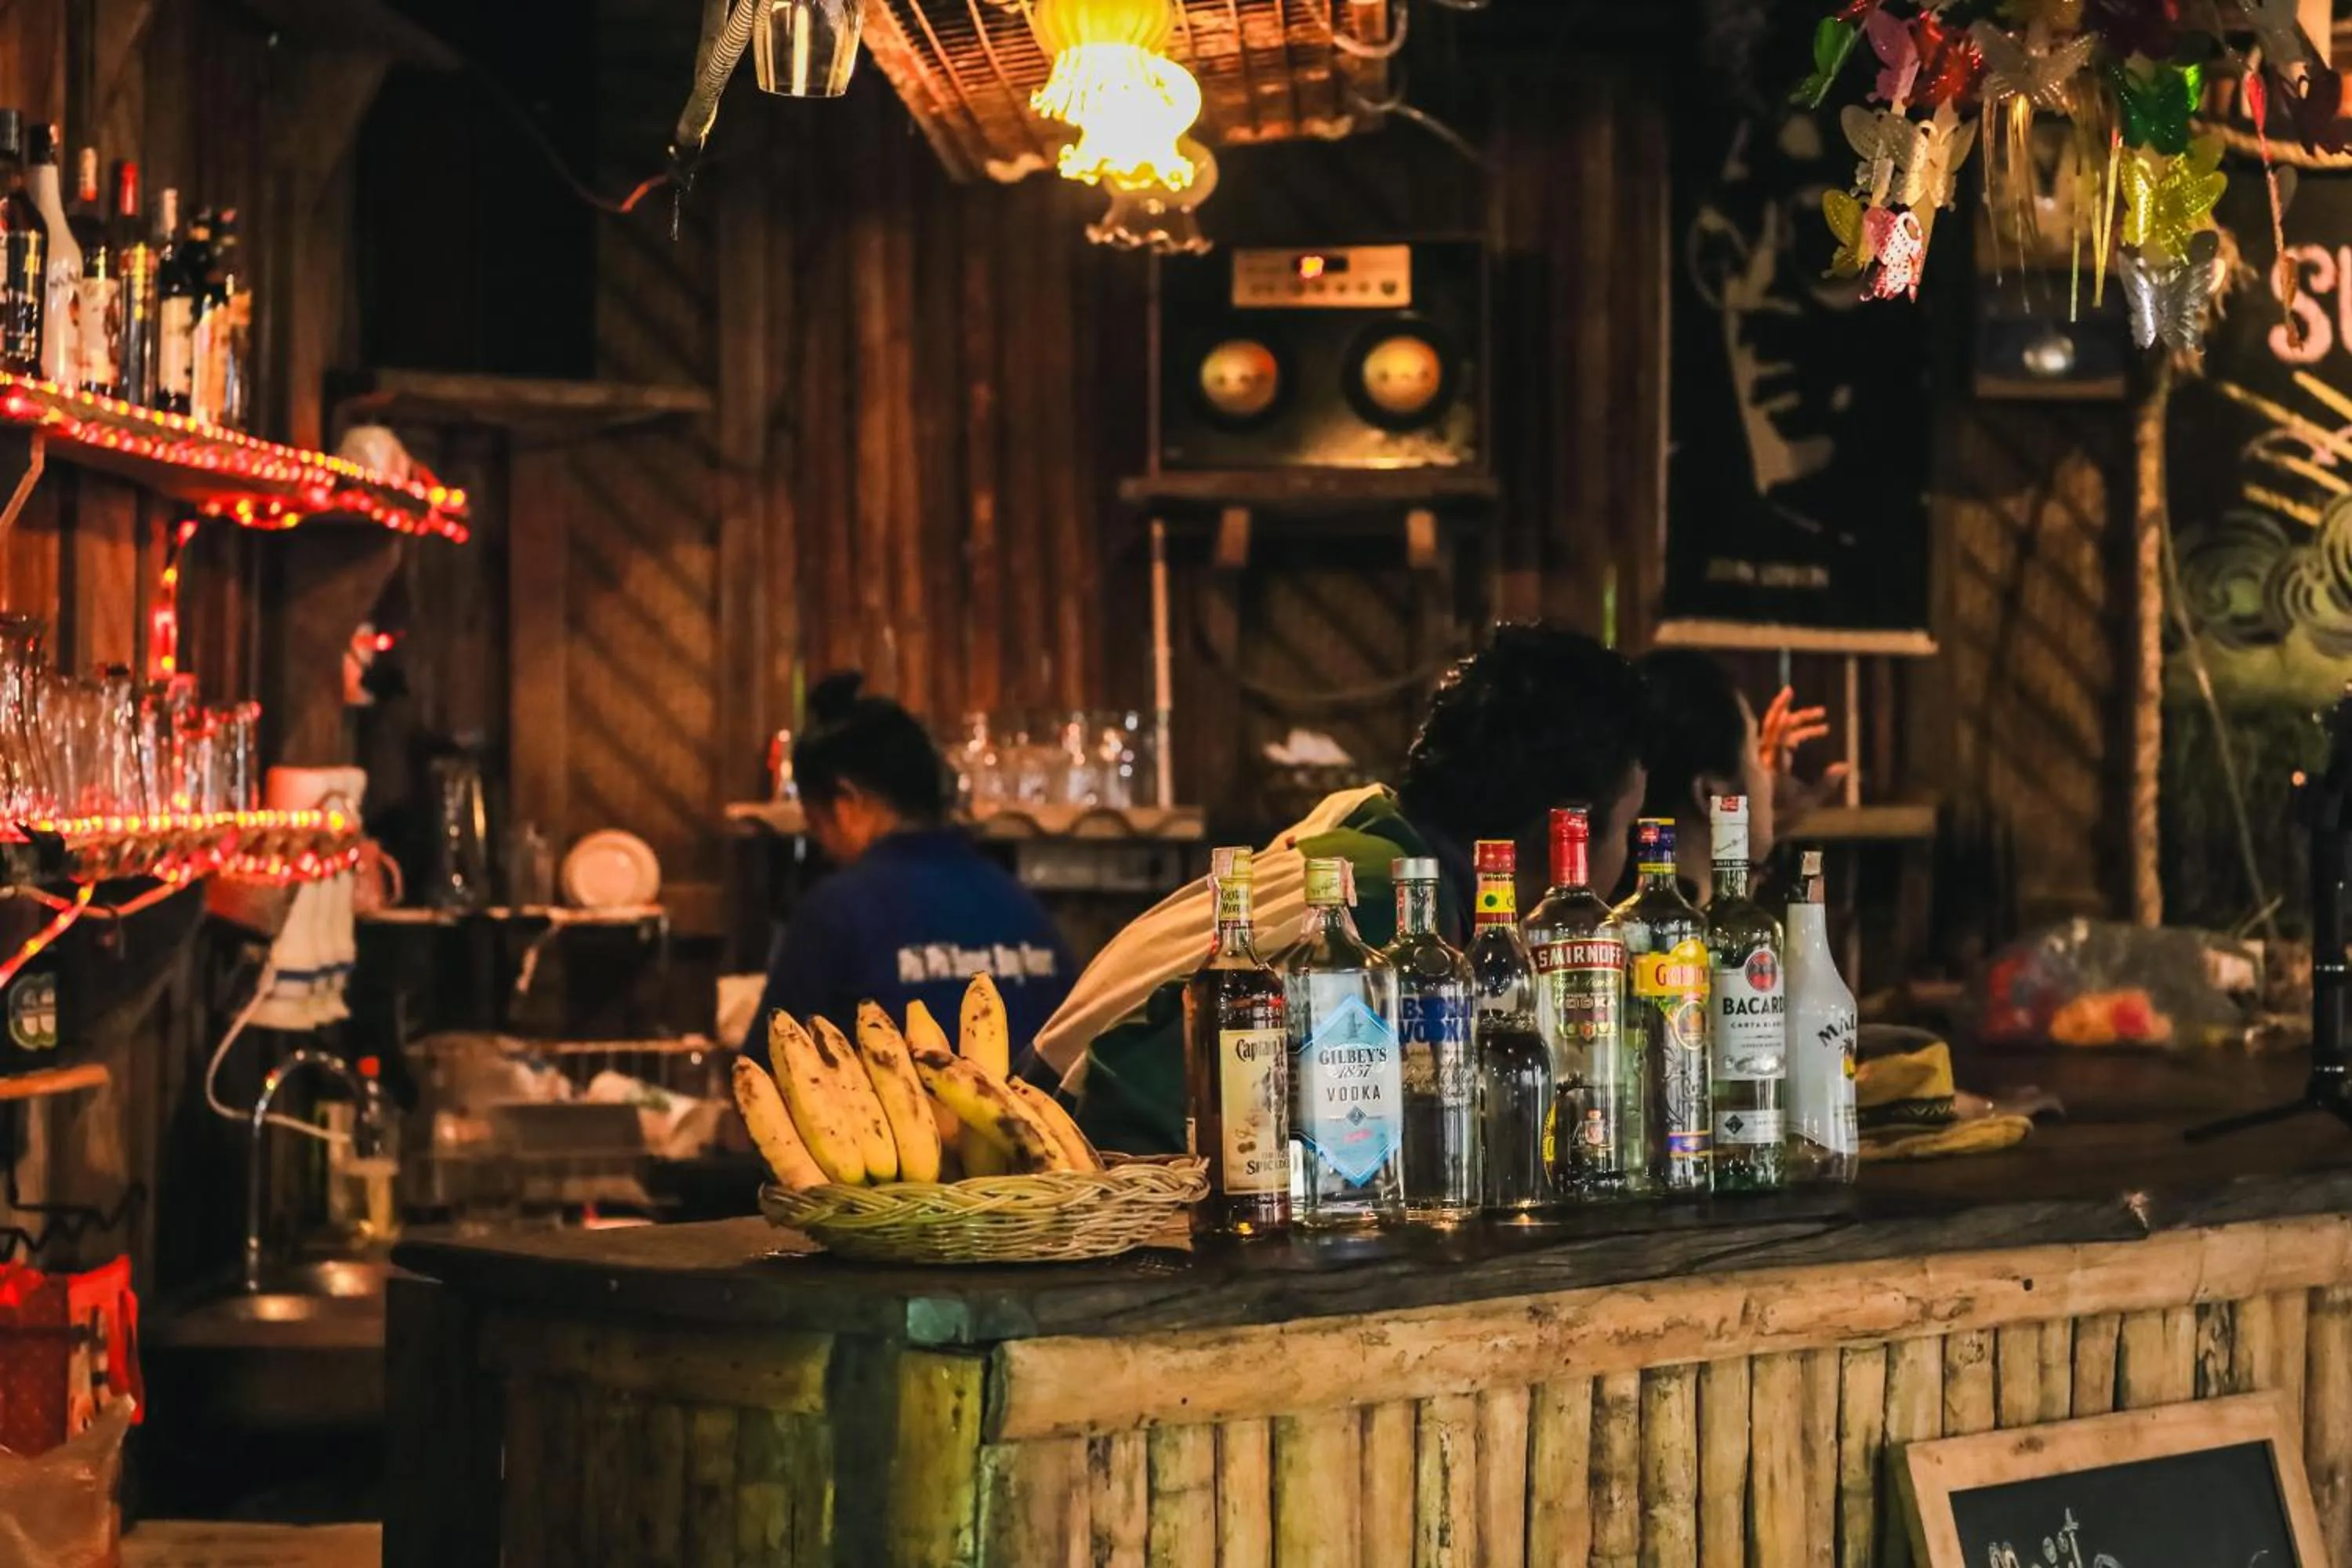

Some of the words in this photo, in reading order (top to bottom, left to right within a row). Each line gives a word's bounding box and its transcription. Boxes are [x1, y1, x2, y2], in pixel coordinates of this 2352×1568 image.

[2268, 244, 2352, 364] S
[1538, 945, 1621, 968] SMIRNOFF
[1319, 1048, 1387, 1065] GILBEY'S
[1327, 1085, 1380, 1102] VODKA
